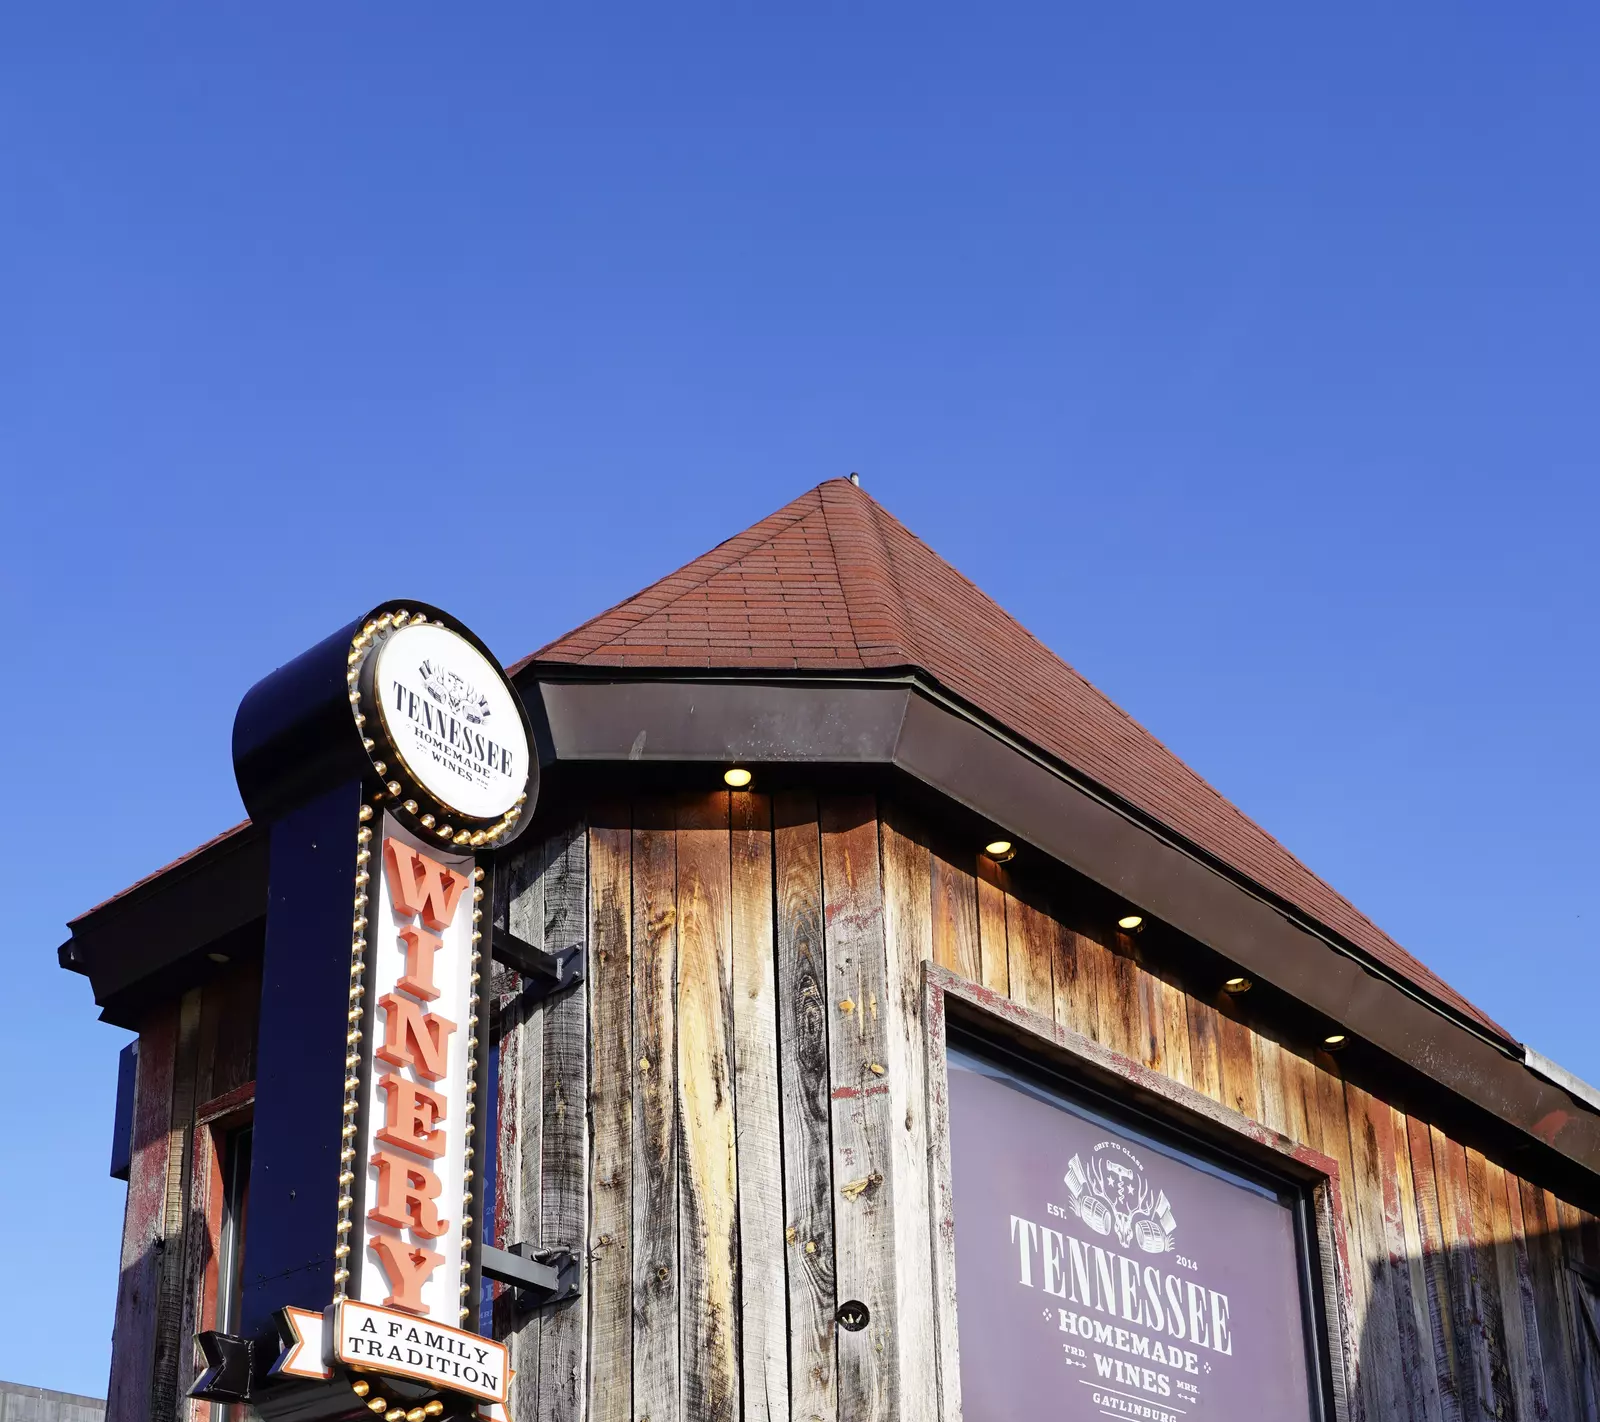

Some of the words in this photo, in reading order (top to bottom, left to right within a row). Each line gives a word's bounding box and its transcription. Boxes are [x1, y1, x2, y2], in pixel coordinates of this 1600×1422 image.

[393, 681, 513, 778] TENNESSEE
[414, 726, 491, 779] HOMEMADE
[431, 750, 473, 782] WINES
[369, 837, 468, 1315] WINERY
[1093, 1141, 1109, 1152] GRIT
[1110, 1142, 1121, 1150] TO
[1122, 1147, 1144, 1171] GLASS
[1047, 1202, 1067, 1219] EST.
[1010, 1214, 1233, 1356] TENNESSEE
[1176, 1254, 1198, 1271] 2014
[348, 1337, 499, 1391] TRADITION
[360, 1317, 378, 1334] A
[387, 1321, 490, 1365] FAMILY
[1057, 1307, 1199, 1375] HOMEMADE
[1062, 1343, 1088, 1359] TRD.
[1093, 1352, 1171, 1397] WINES
[1176, 1379, 1200, 1394] MRK.
